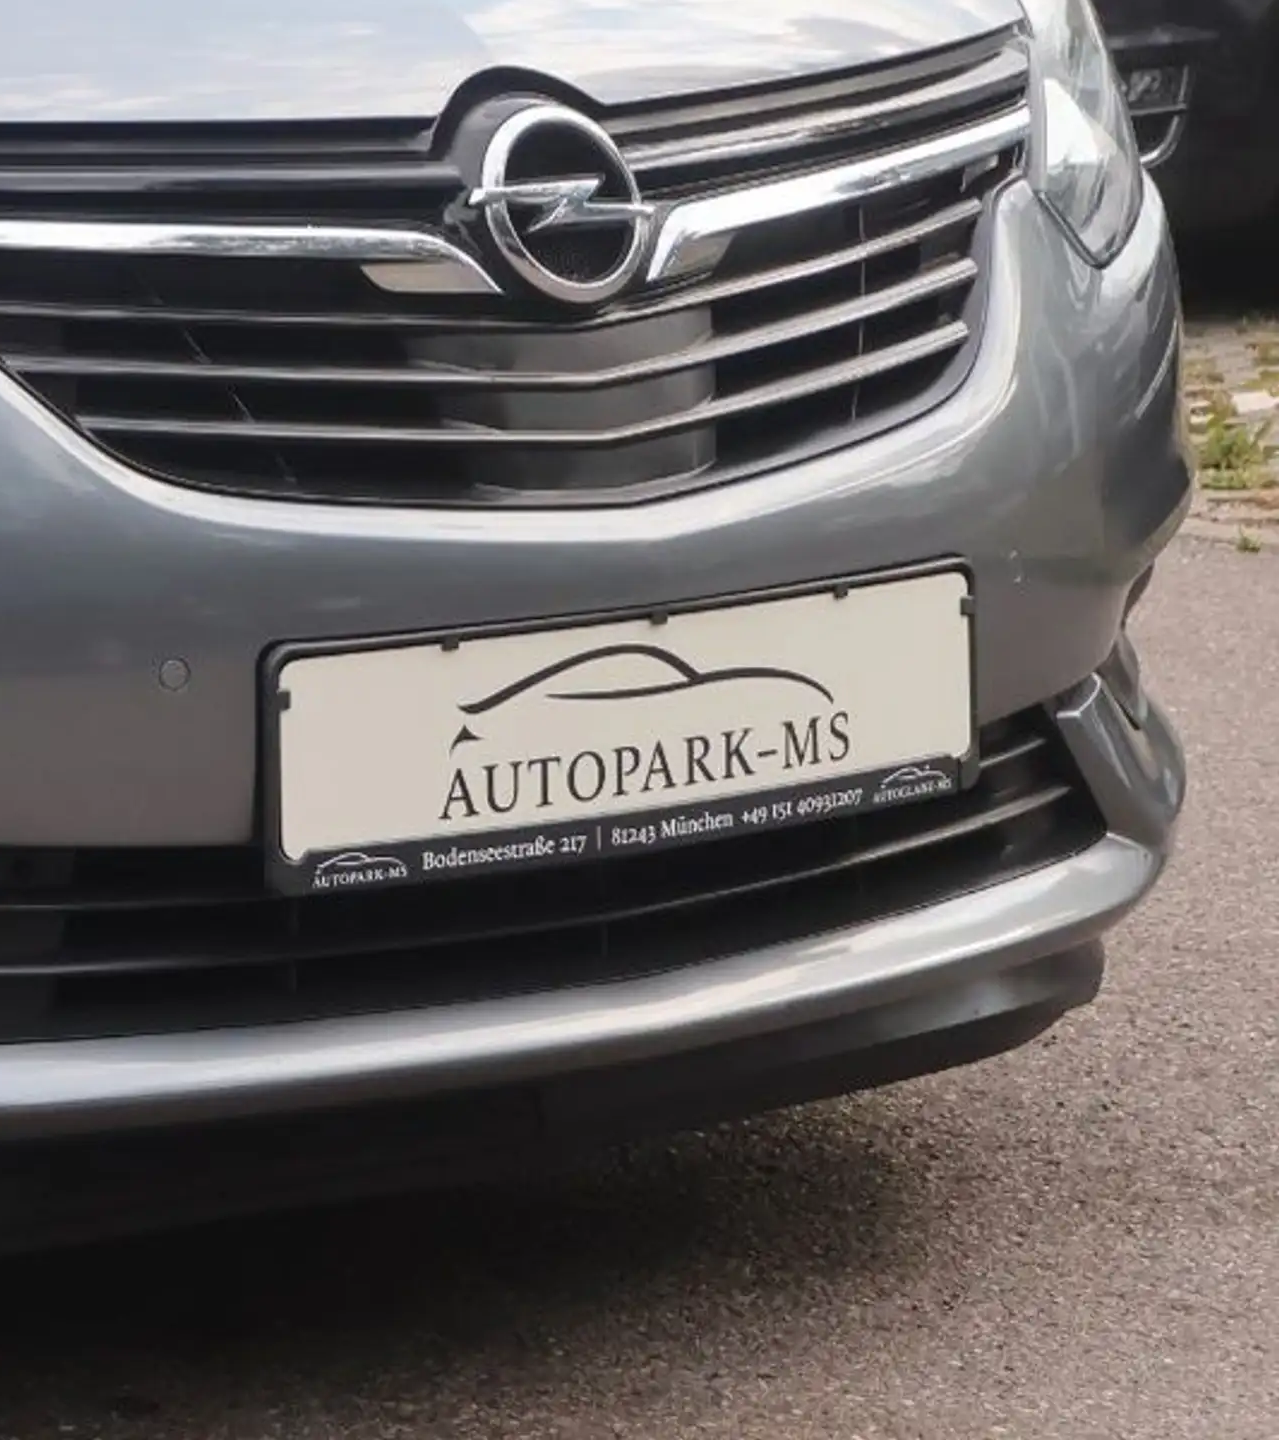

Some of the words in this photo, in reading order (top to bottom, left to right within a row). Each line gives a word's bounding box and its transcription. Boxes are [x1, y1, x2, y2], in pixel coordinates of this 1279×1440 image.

[438, 710, 850, 820] AUTOPARK-MS
[422, 835, 556, 871] Bodenseestraße
[559, 835, 588, 856] 217
[611, 825, 656, 846] 81243
[661, 811, 734, 839] München
[741, 805, 768, 825] +49
[311, 866, 408, 889] AUTOPARK-MS
